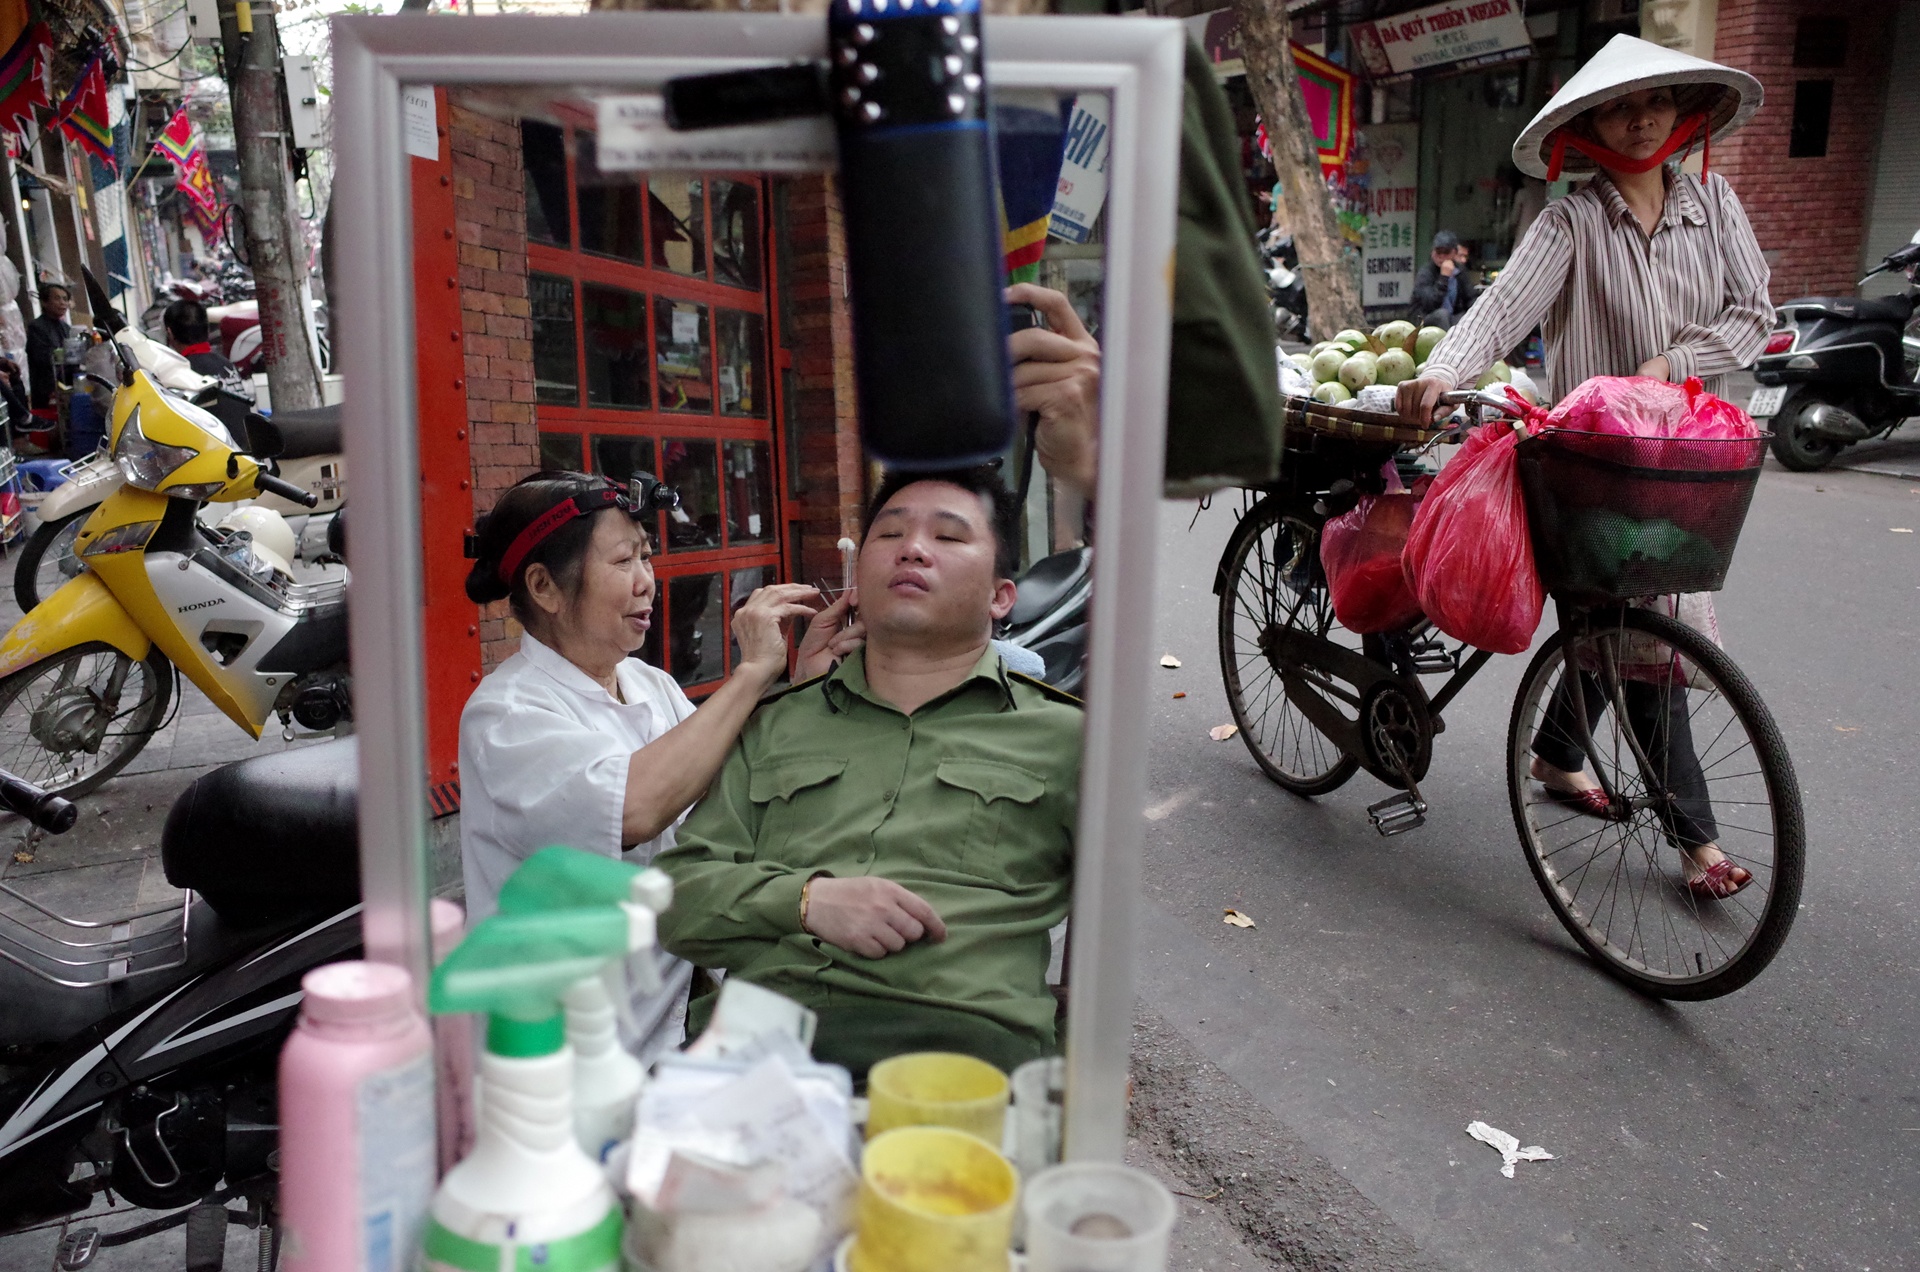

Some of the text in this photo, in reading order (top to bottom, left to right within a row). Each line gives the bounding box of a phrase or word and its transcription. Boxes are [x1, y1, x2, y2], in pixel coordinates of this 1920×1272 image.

[1366, 256, 1413, 274] GEMSTONE
[1378, 281, 1399, 298] RUBY
[178, 597, 226, 613] HONDA
